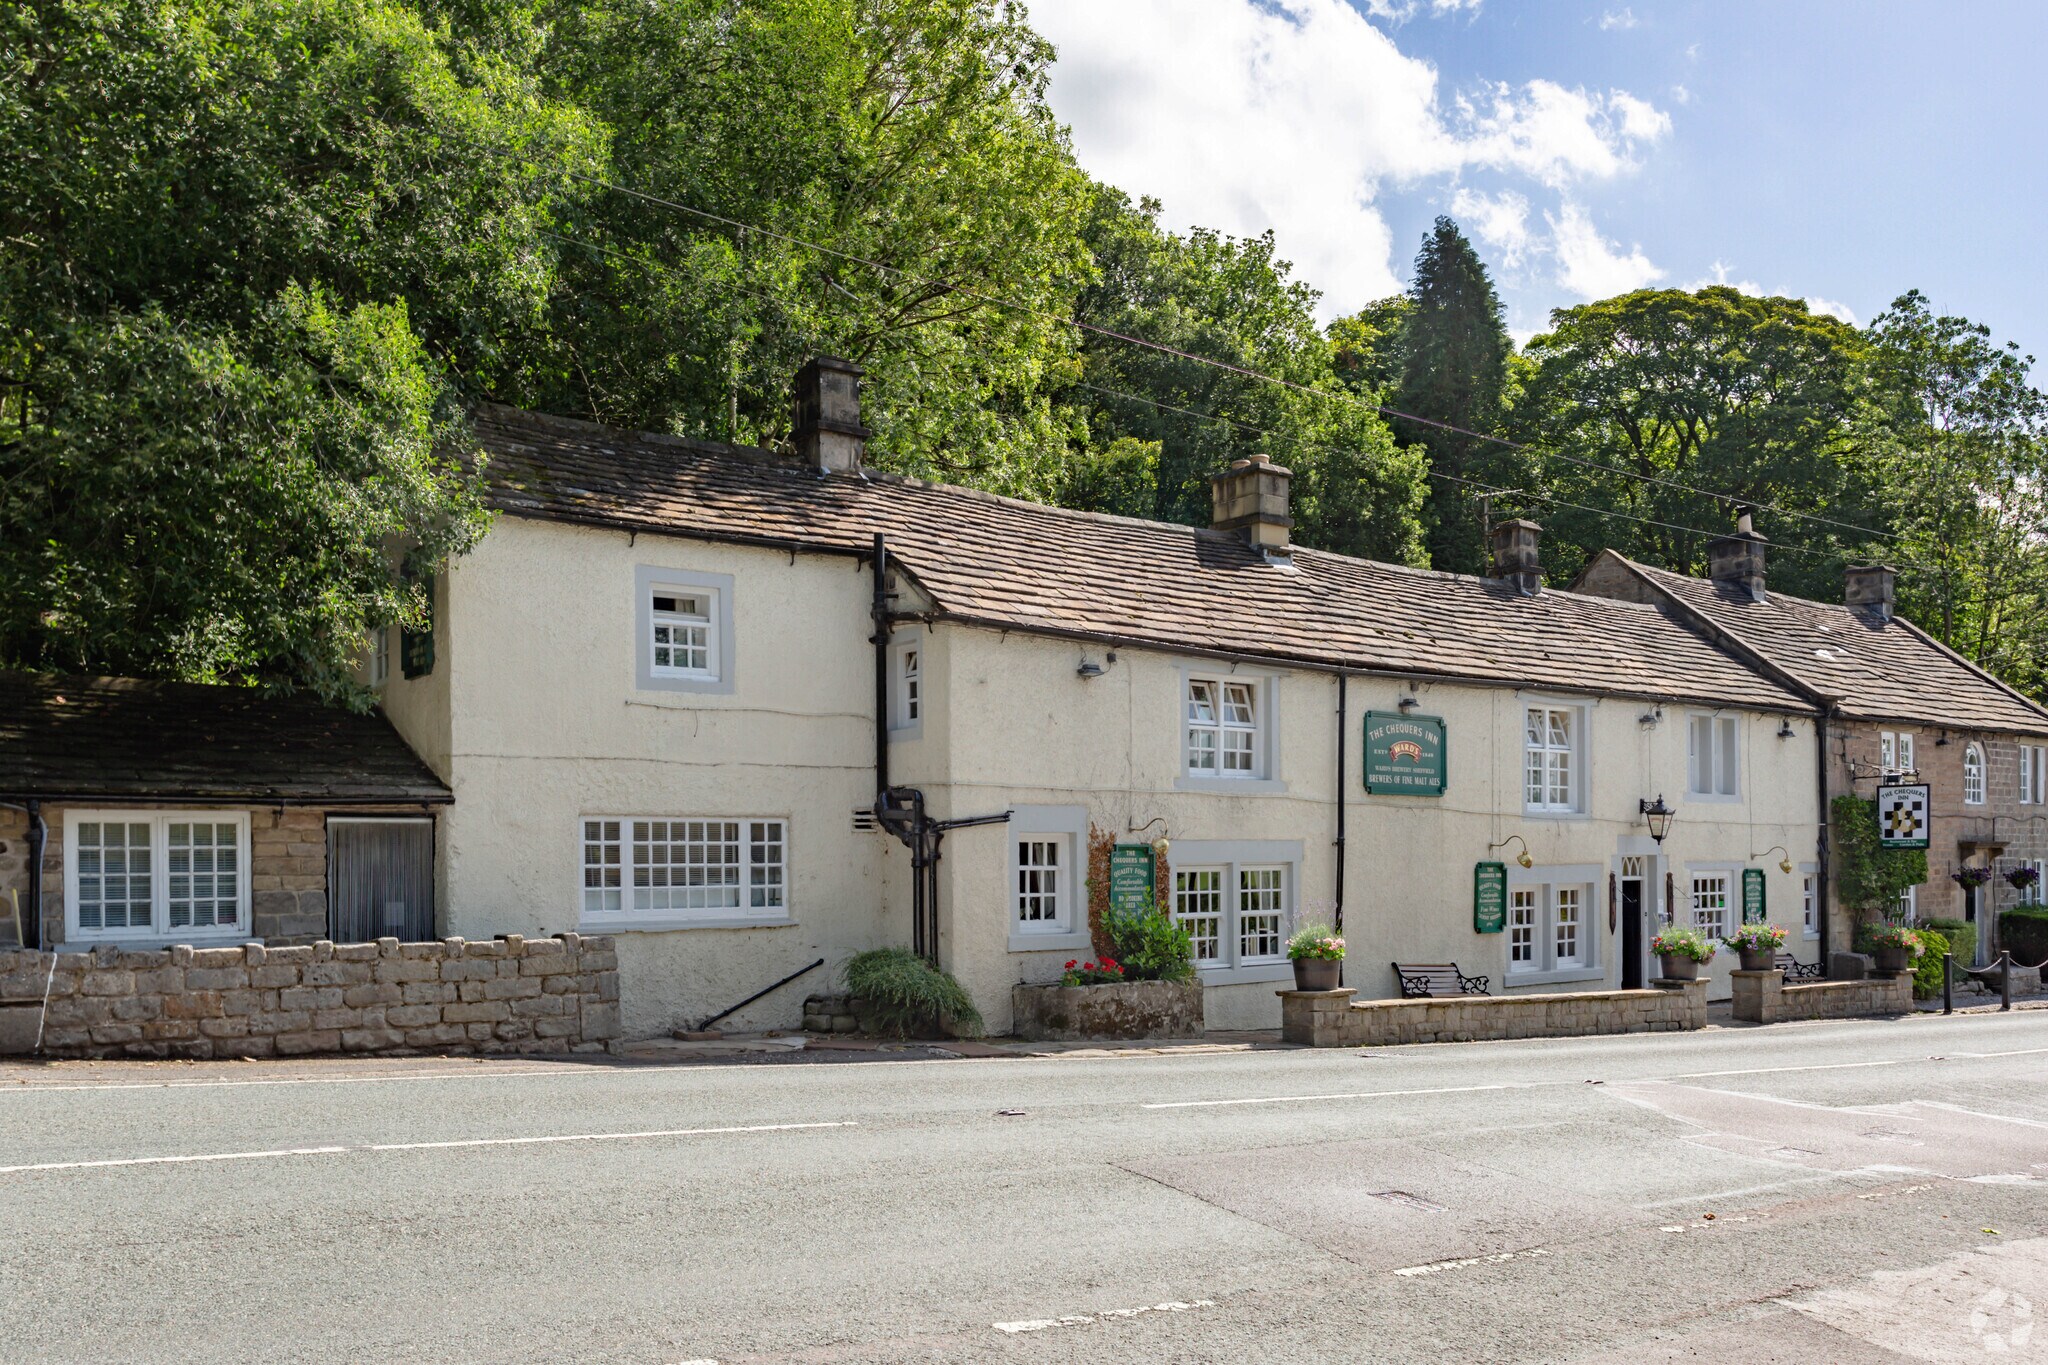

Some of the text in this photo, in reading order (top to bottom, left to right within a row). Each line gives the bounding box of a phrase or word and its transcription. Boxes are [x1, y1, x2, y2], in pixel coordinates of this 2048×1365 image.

[1369, 724, 1439, 746] THE CHEQUERS INN
[1369, 774, 1440, 786] BREWERS OF FINE MALT ALES
[1881, 788, 1926, 799] THE CHEQUERS
[1113, 867, 1147, 878] QUALITY FOOD
